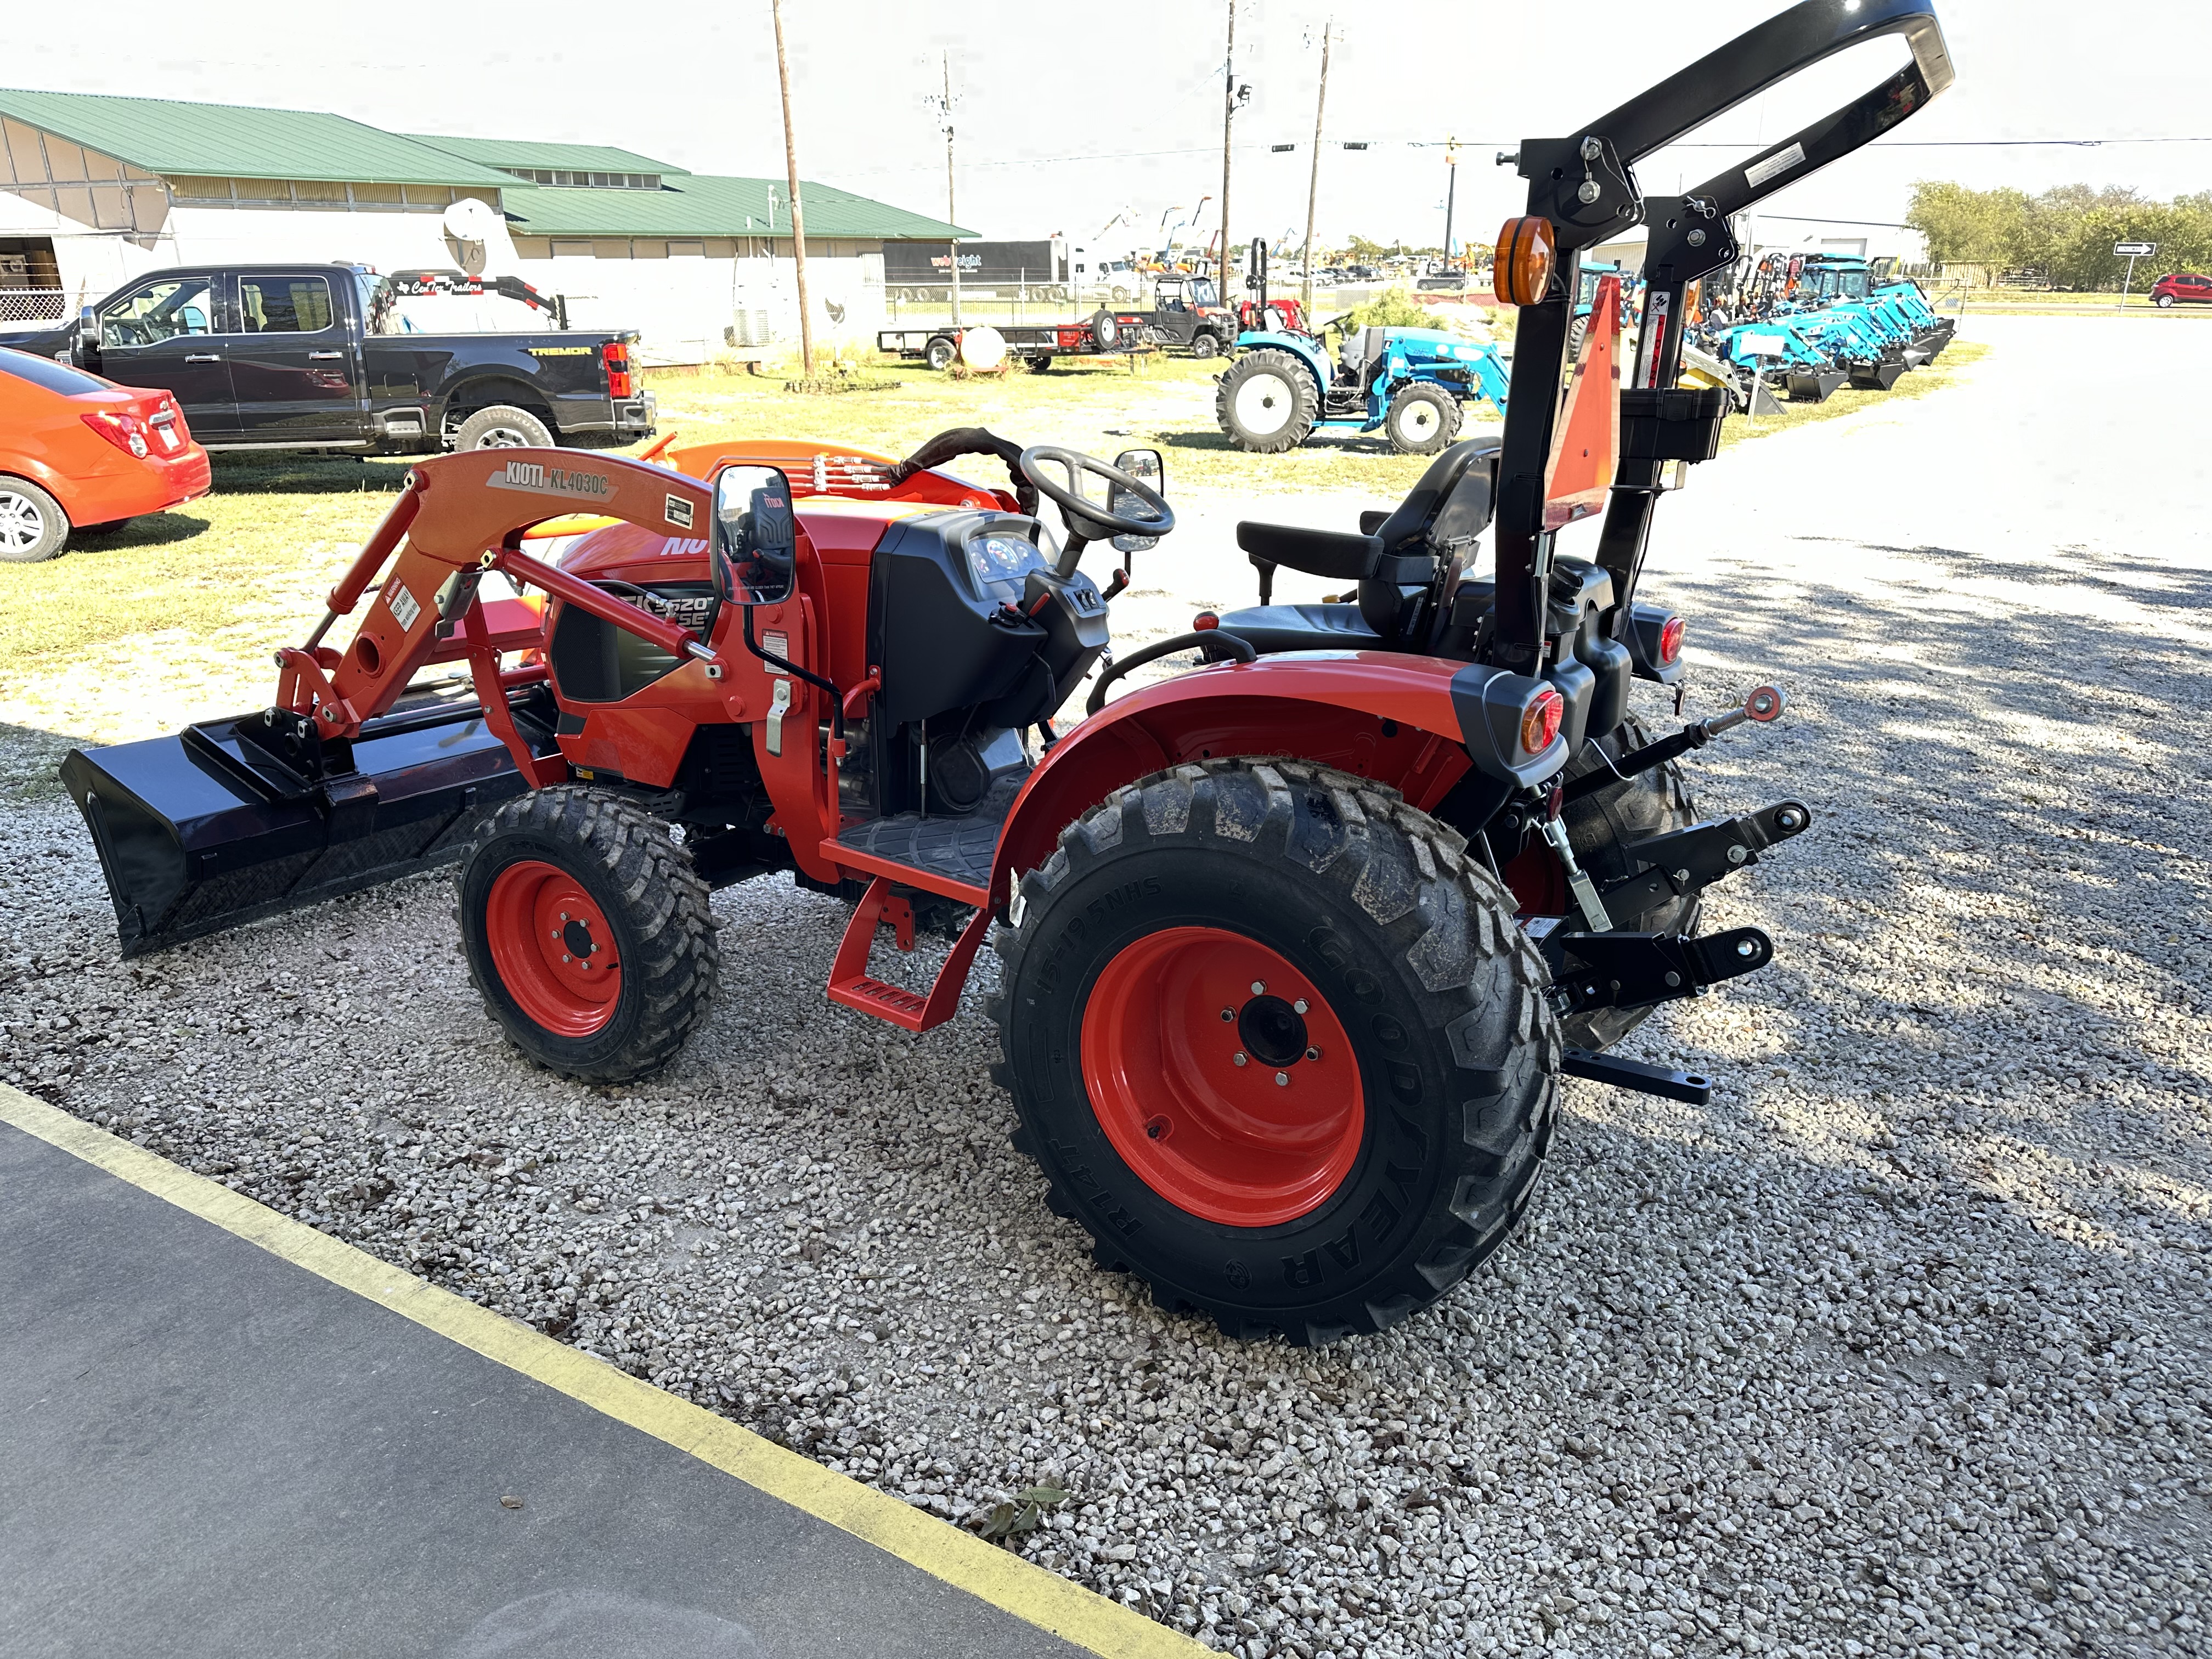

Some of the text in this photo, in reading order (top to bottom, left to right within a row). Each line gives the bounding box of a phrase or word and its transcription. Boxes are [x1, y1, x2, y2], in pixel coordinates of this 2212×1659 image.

[930, 255, 982, 269] webeight
[445, 280, 482, 292] Trailers
[528, 347, 592, 356] TREMOR
[505, 460, 608, 495] KIOTI KL4030C
[387, 577, 401, 597] WARNING
[392, 589, 410, 618] KEEP AWAY
[1280, 923, 1430, 1289] GOODYEAR
[1049, 1138, 1146, 1241] R14T
